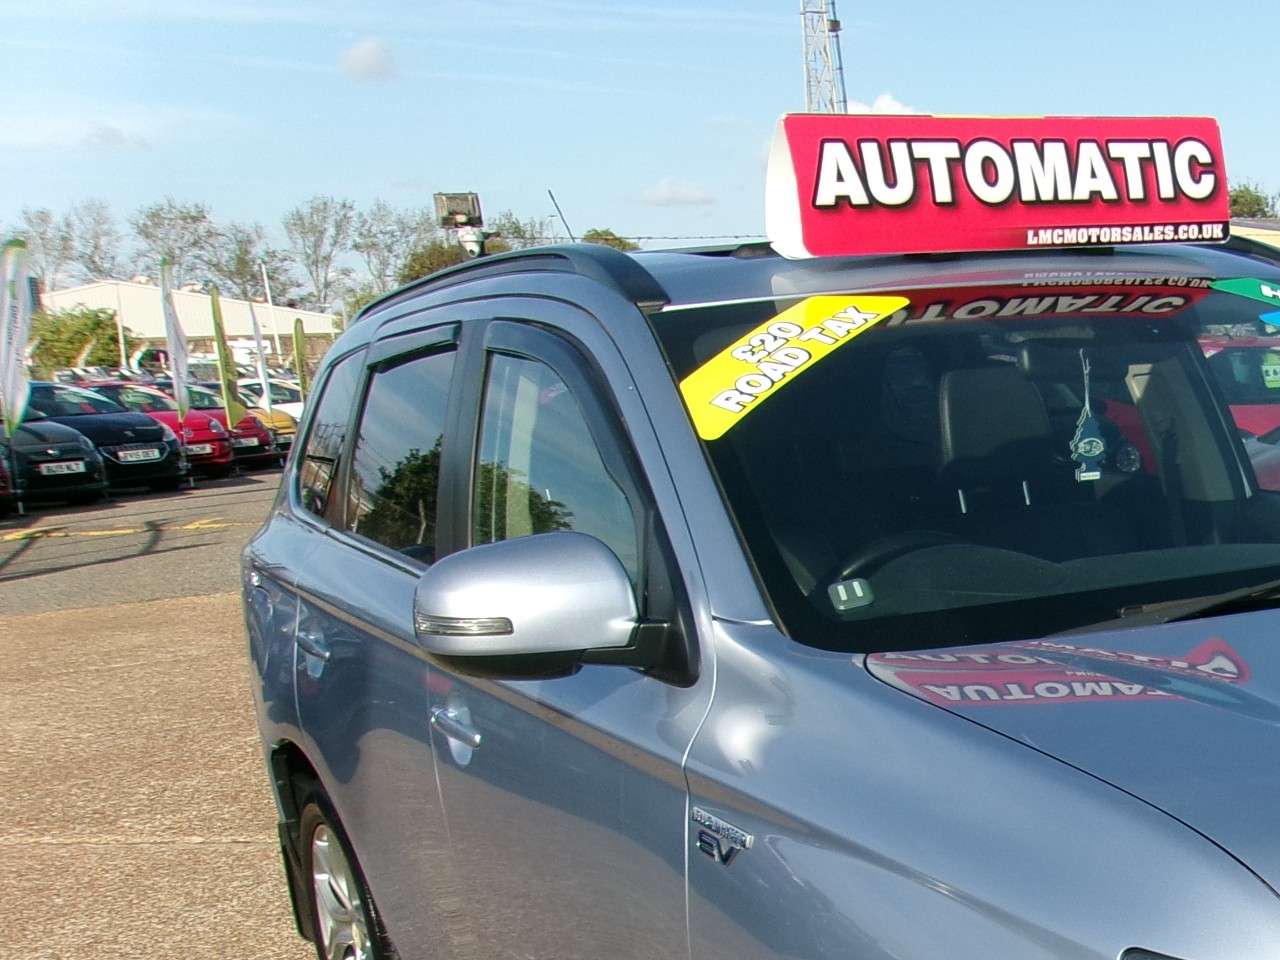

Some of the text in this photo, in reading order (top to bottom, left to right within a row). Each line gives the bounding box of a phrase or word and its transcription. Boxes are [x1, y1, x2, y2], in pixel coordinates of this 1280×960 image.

[812, 137, 1218, 209] AUTOMATIC
[1027, 224, 1224, 246] LMCMOTORSALES.CO.UK
[709, 305, 881, 413] ROAD TAX
[731, 321, 805, 364] £20
[698, 828, 742, 867] EV
